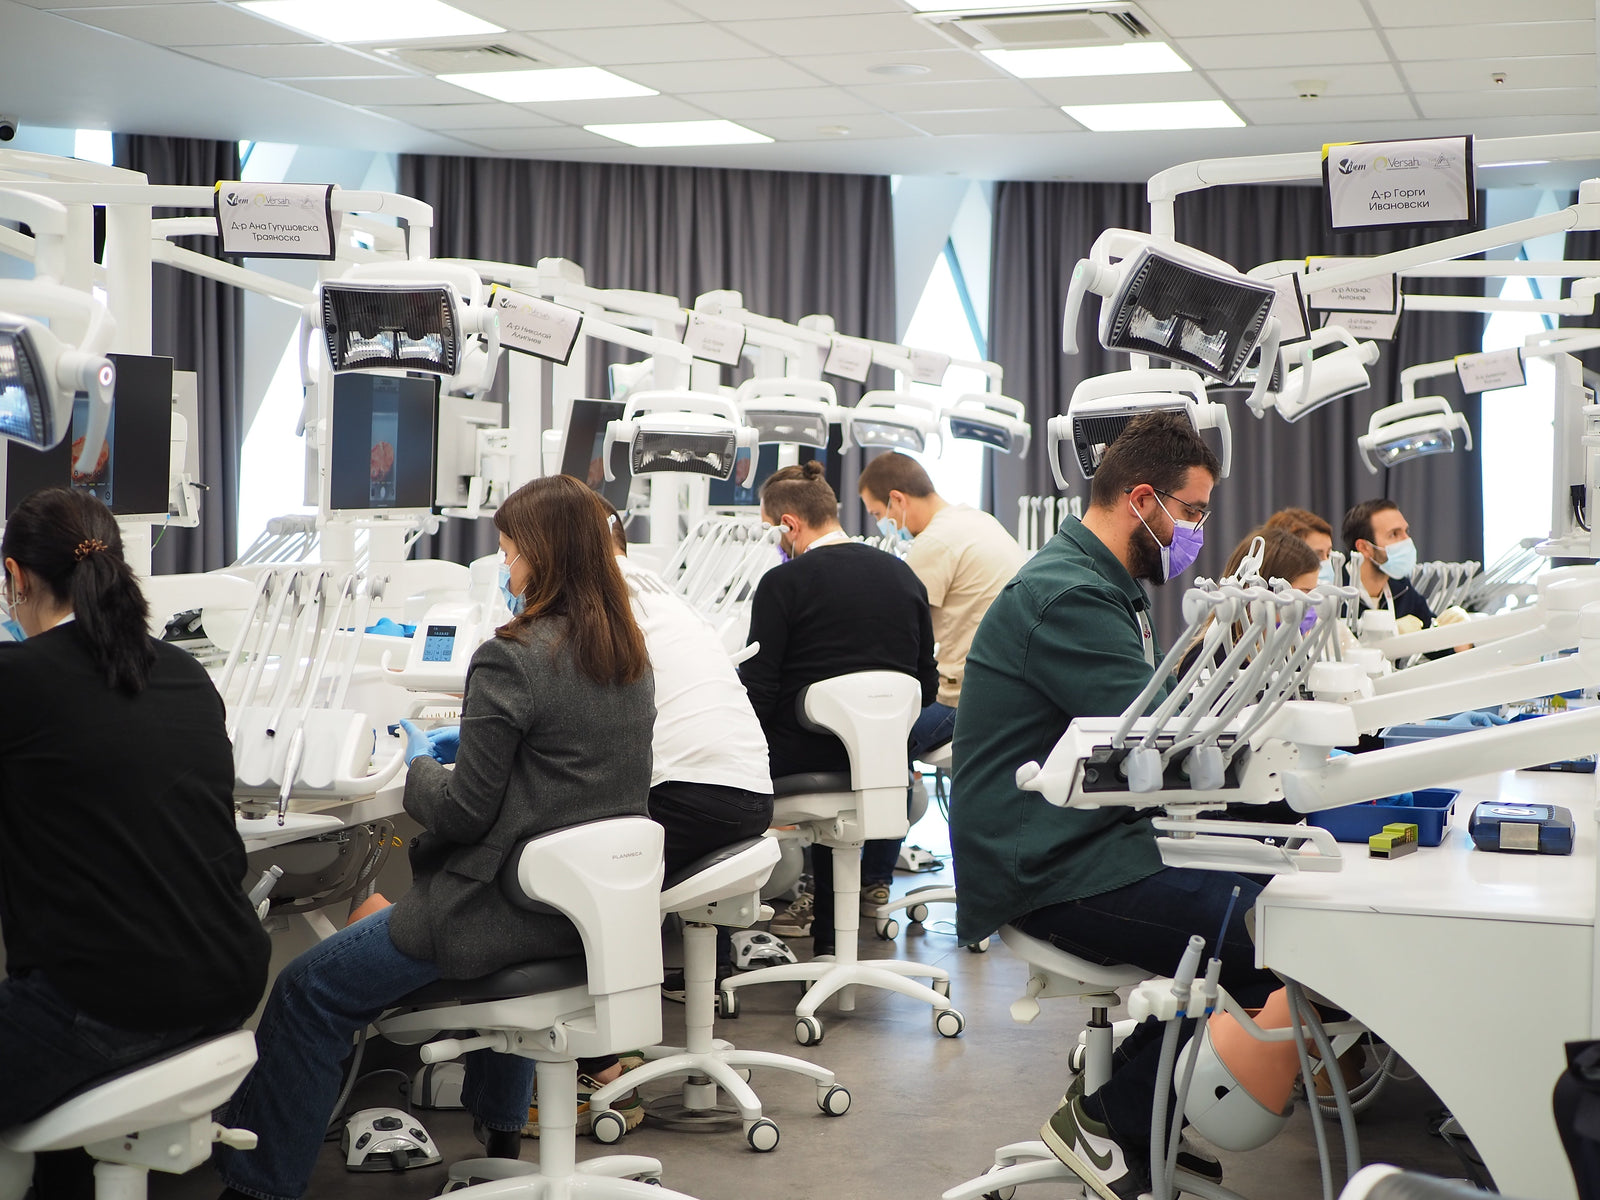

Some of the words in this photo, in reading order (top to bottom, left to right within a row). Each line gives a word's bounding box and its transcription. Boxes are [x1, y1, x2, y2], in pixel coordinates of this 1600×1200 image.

[1386, 156, 1421, 168] Versah
[265, 195, 290, 204] Versah
[1371, 190, 1392, 200] Д-р
[1394, 189, 1426, 199] Горги
[1369, 200, 1430, 211] Ивановски
[231, 222, 247, 230] Д-р
[249, 222, 267, 230] Ана
[268, 223, 319, 232] Гугушовска
[252, 233, 301, 242] Траяноска
[612, 851, 642, 859] PLANMECA
